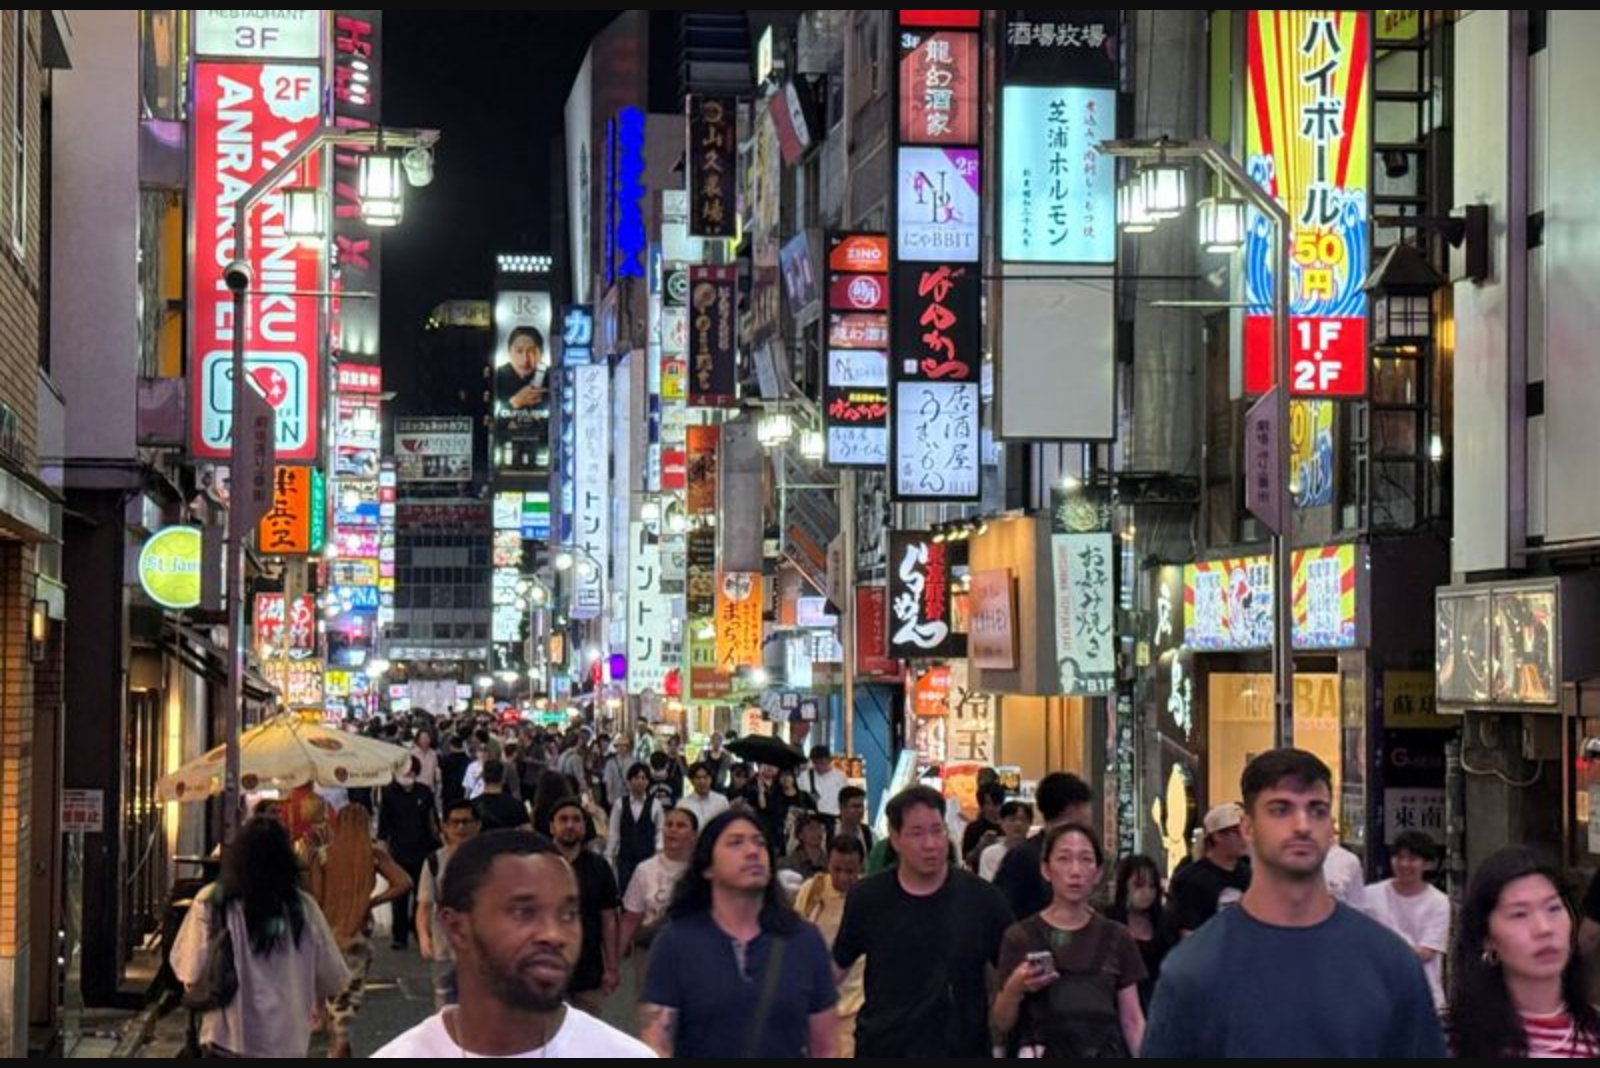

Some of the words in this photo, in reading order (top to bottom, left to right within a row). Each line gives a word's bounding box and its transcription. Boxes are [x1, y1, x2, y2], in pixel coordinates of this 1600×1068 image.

[235, 26, 279, 49] 3F
[901, 33, 921, 48] 3F
[1008, 22, 1106, 47] 酒場牧場
[275, 76, 312, 100] 2F
[1303, 21, 1341, 223] ハイボール
[955, 157, 978, 176] 2F
[1048, 100, 1068, 246] 芝浦ホルモン
[1293, 231, 1343, 266] 50
[1303, 268, 1334, 300] 円
[1297, 321, 1342, 350] 1F
[1294, 360, 1342, 391] 2F
